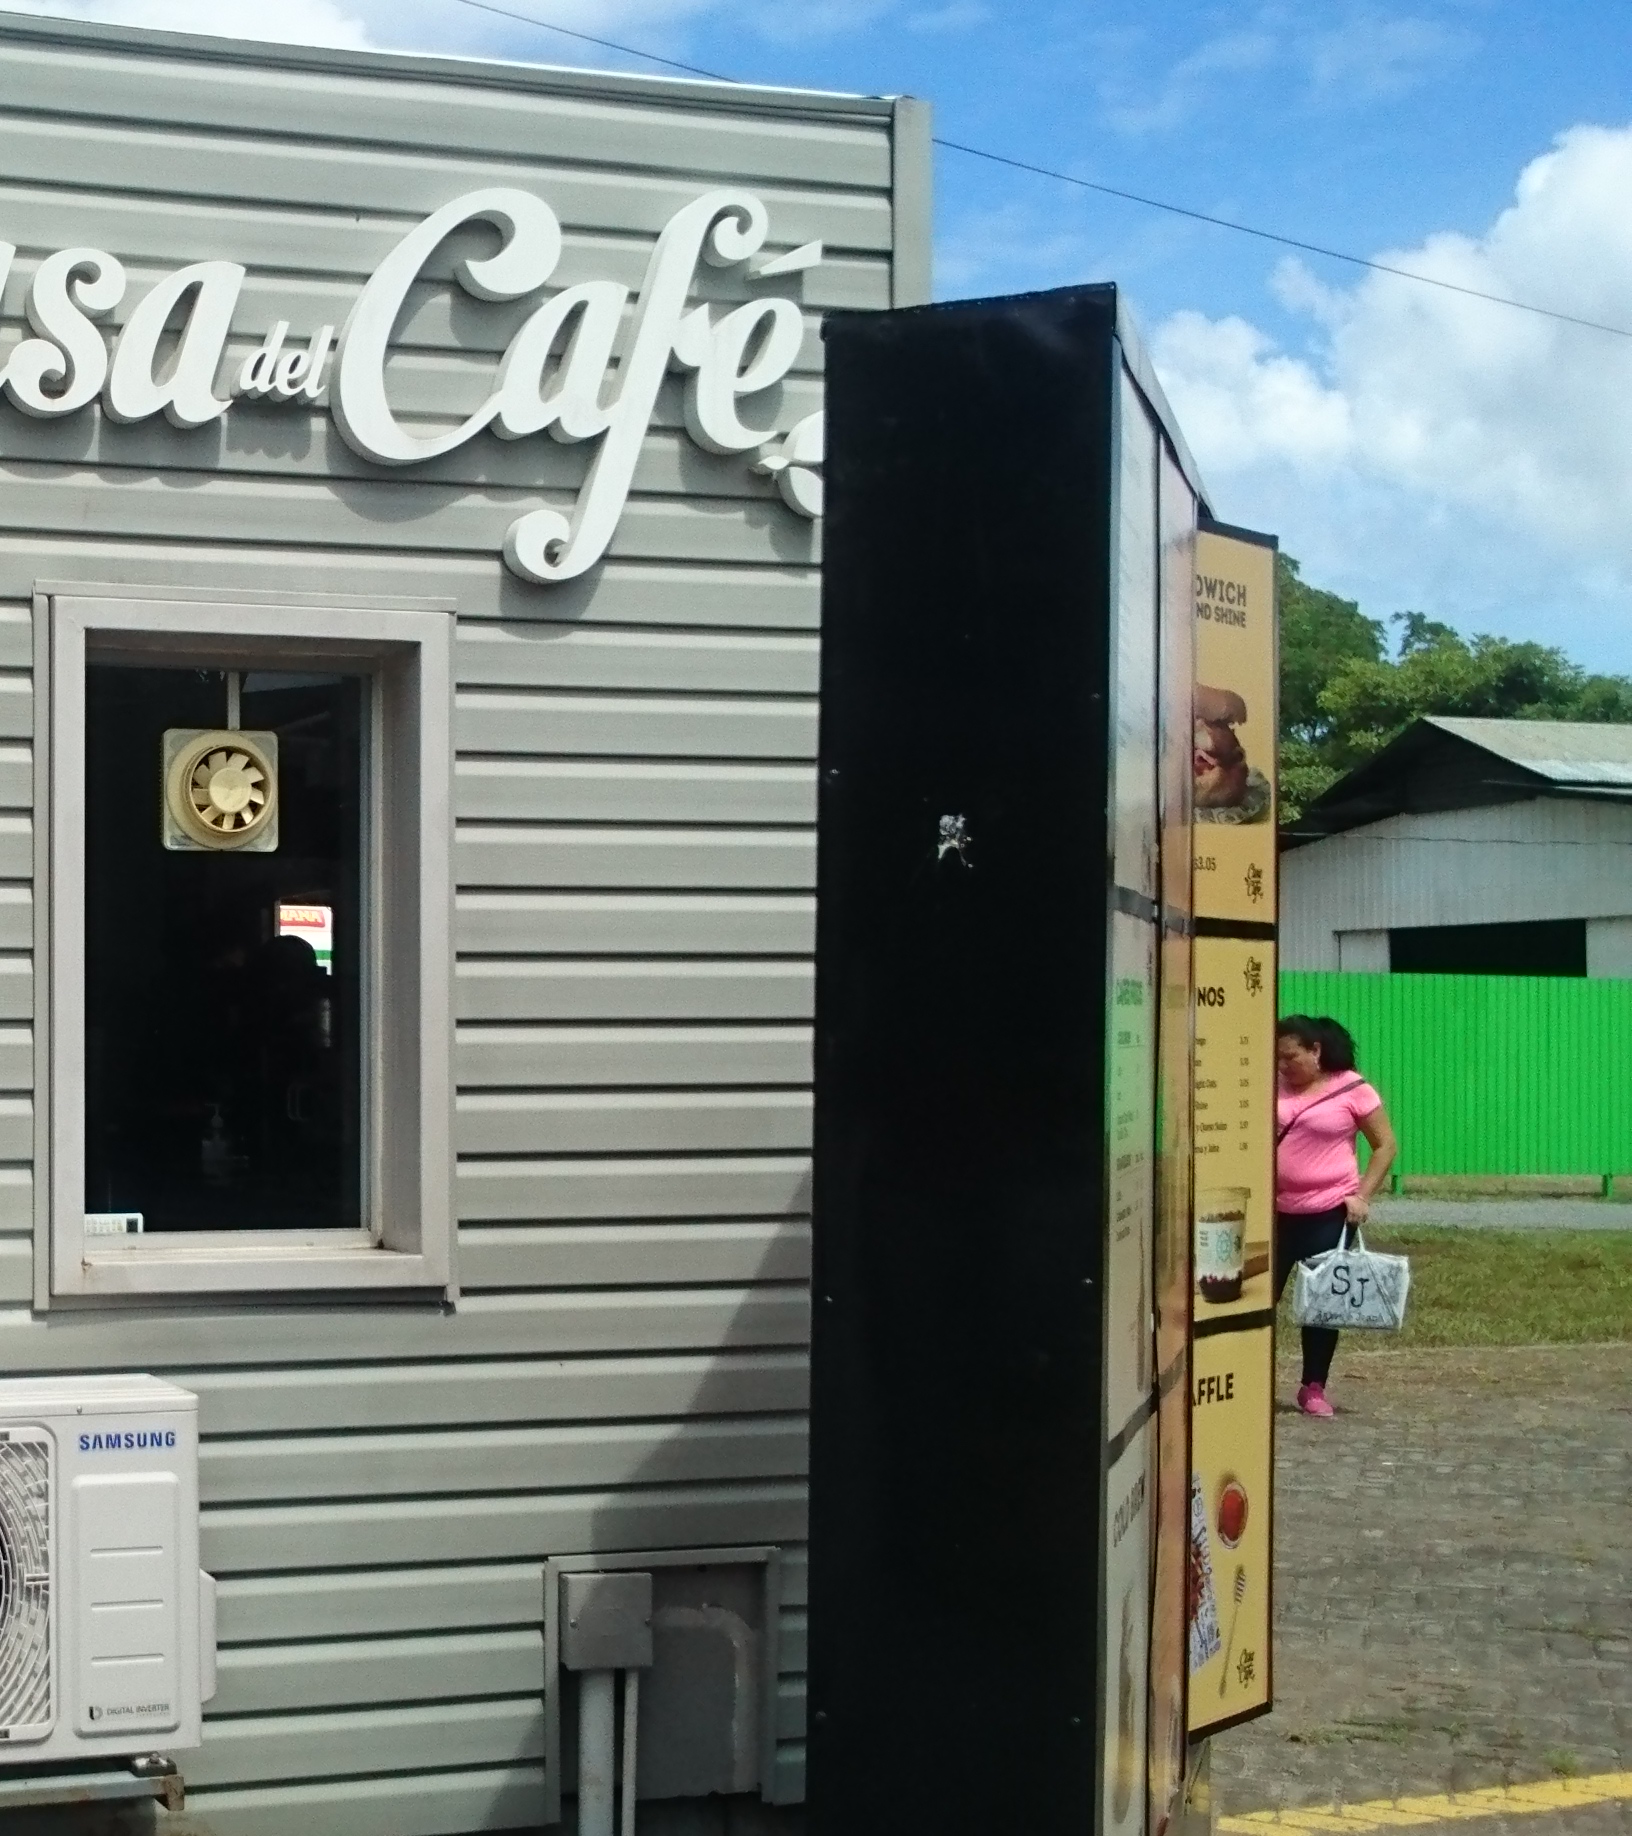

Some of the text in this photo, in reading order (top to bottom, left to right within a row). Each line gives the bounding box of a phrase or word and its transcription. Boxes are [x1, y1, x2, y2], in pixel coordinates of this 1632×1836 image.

[240, 320, 335, 400] del
[329, 186, 823, 583] Café
[1196, 574, 1246, 607] DWICH
[1196, 602, 1211, 620] ND
[1197, 986, 1225, 1007] NOS
[79, 1431, 177, 1451] SAMSUNG
